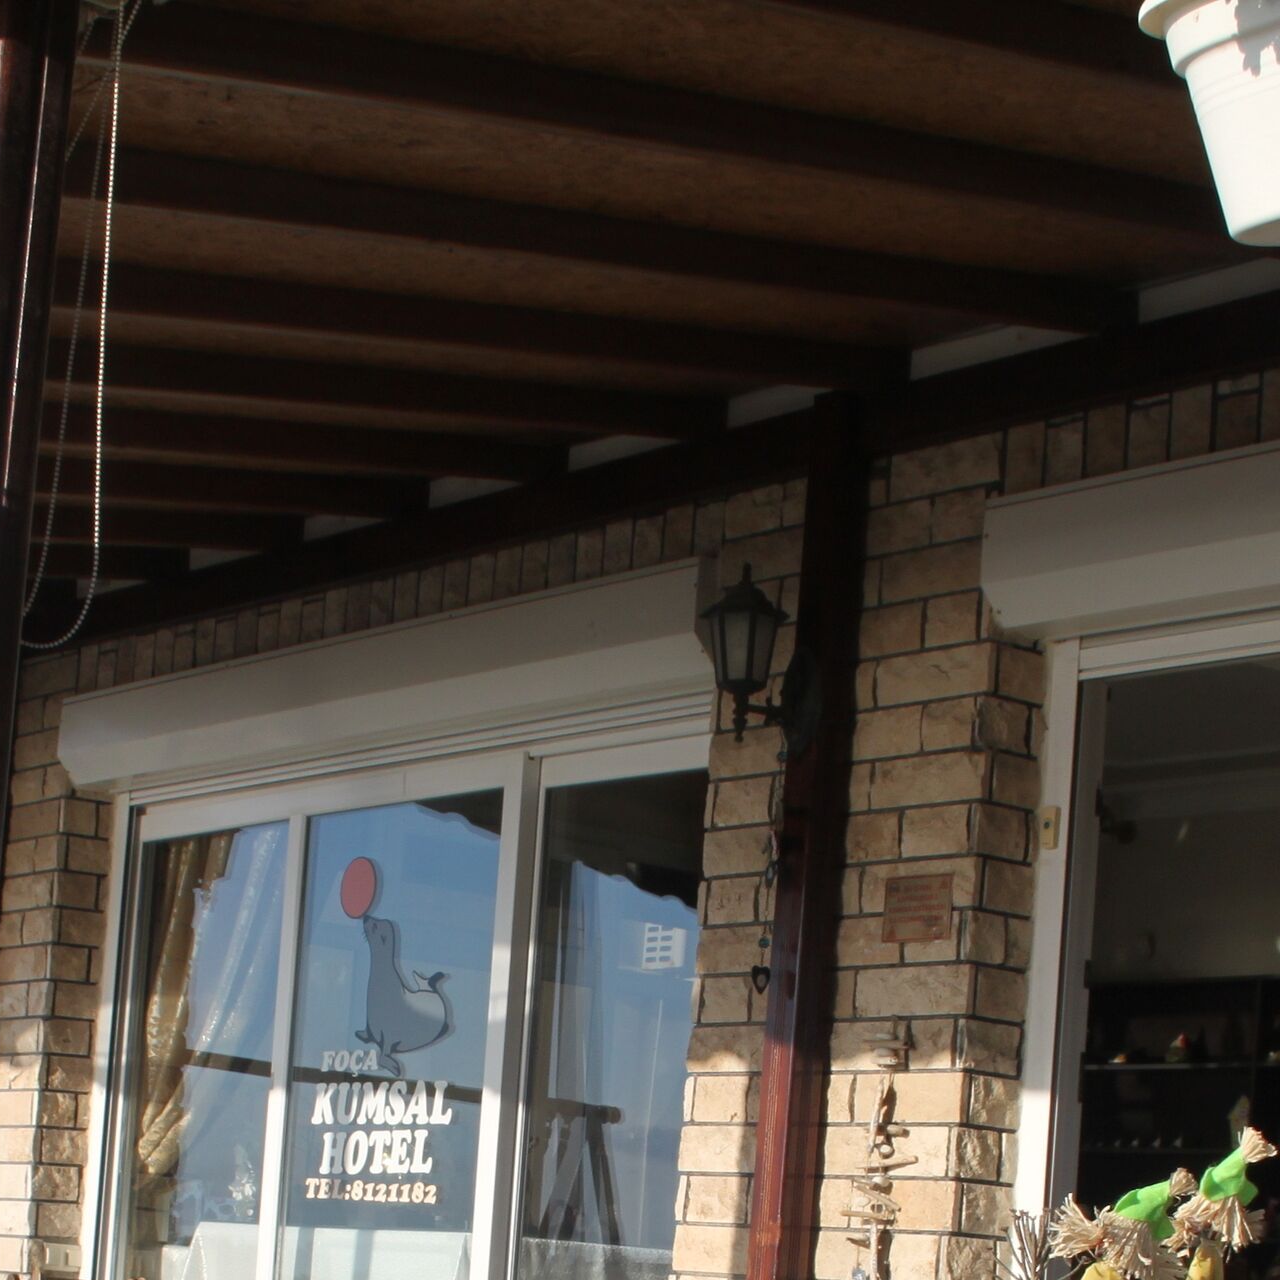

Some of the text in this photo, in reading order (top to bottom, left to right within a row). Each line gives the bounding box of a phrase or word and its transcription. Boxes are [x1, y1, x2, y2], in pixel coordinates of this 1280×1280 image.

[321, 1049, 379, 1077] FOÇA
[311, 1080, 452, 1125] KUMSAL
[319, 1129, 433, 1175] HOTEL
[305, 1178, 437, 1204] TEL:8121182
